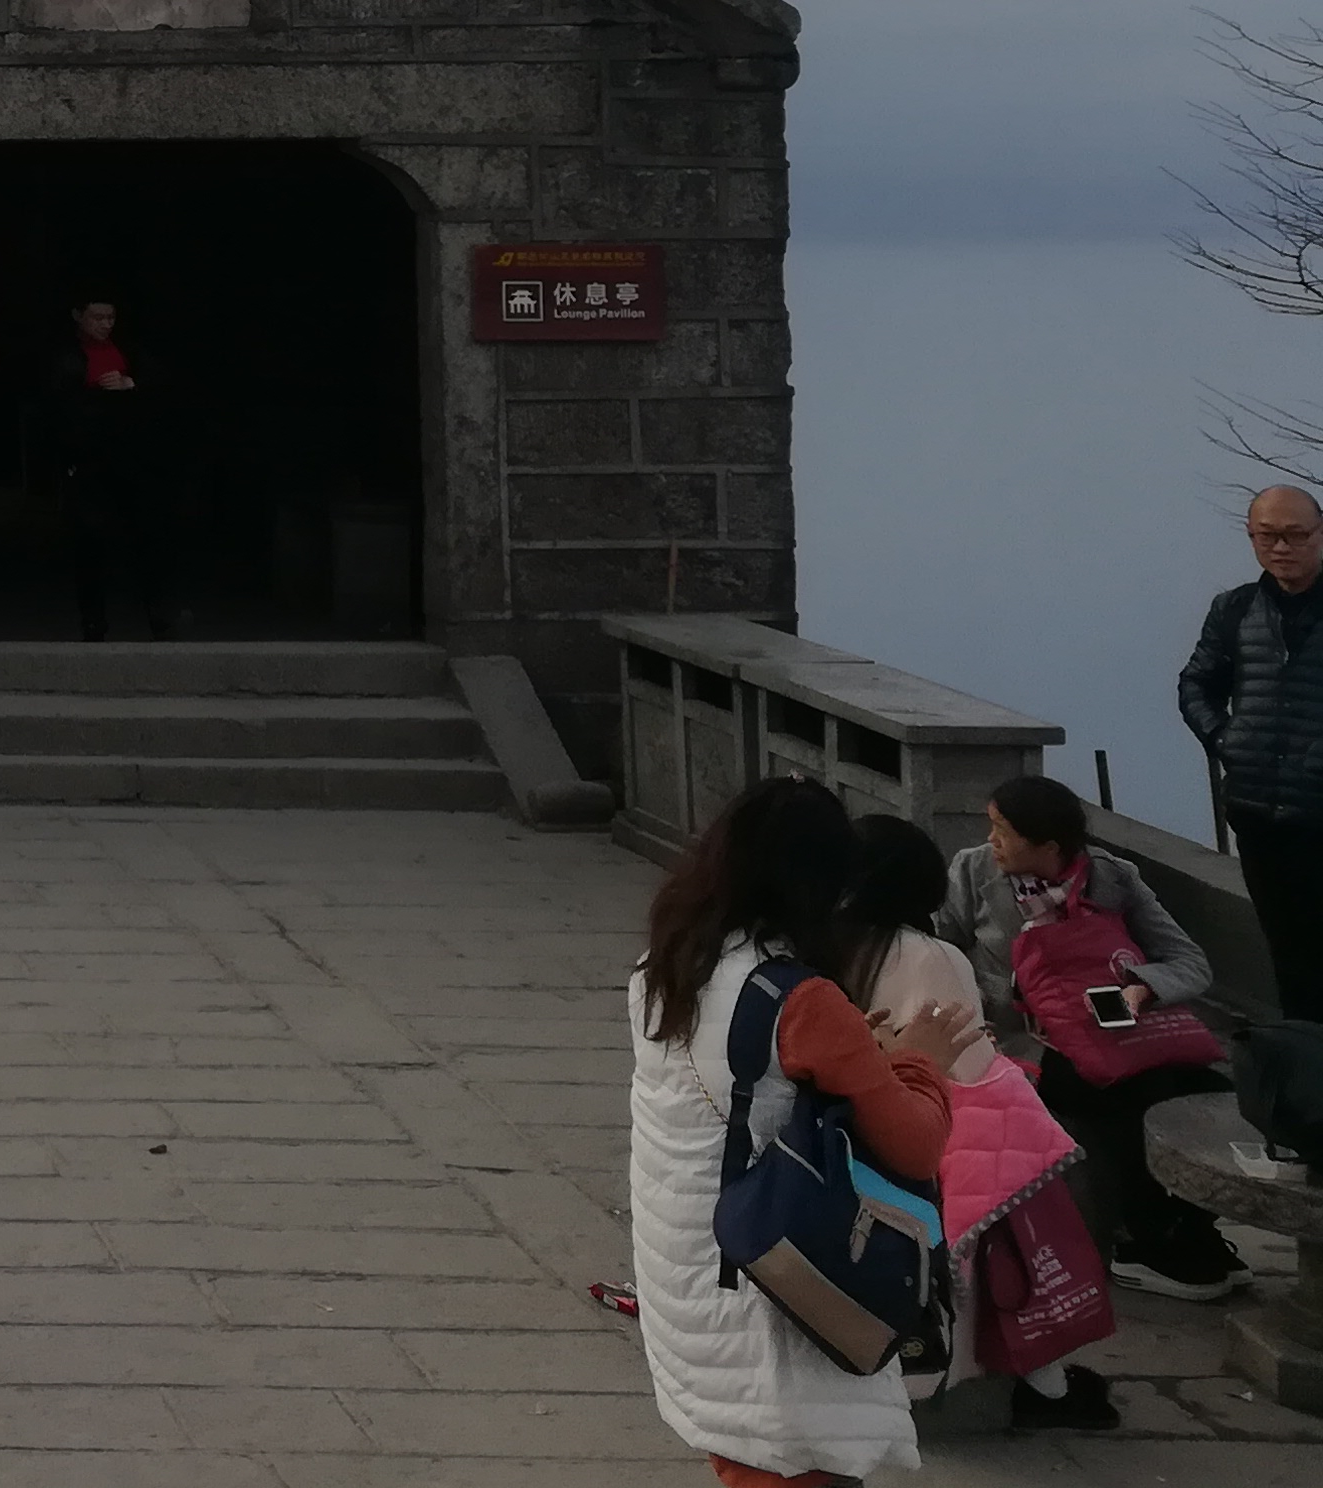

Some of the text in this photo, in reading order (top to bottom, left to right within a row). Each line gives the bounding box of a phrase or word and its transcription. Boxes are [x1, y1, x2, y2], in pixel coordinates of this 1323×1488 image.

[553, 282, 640, 306] 休息亭
[554, 308, 646, 321] Lounge Pavilion
